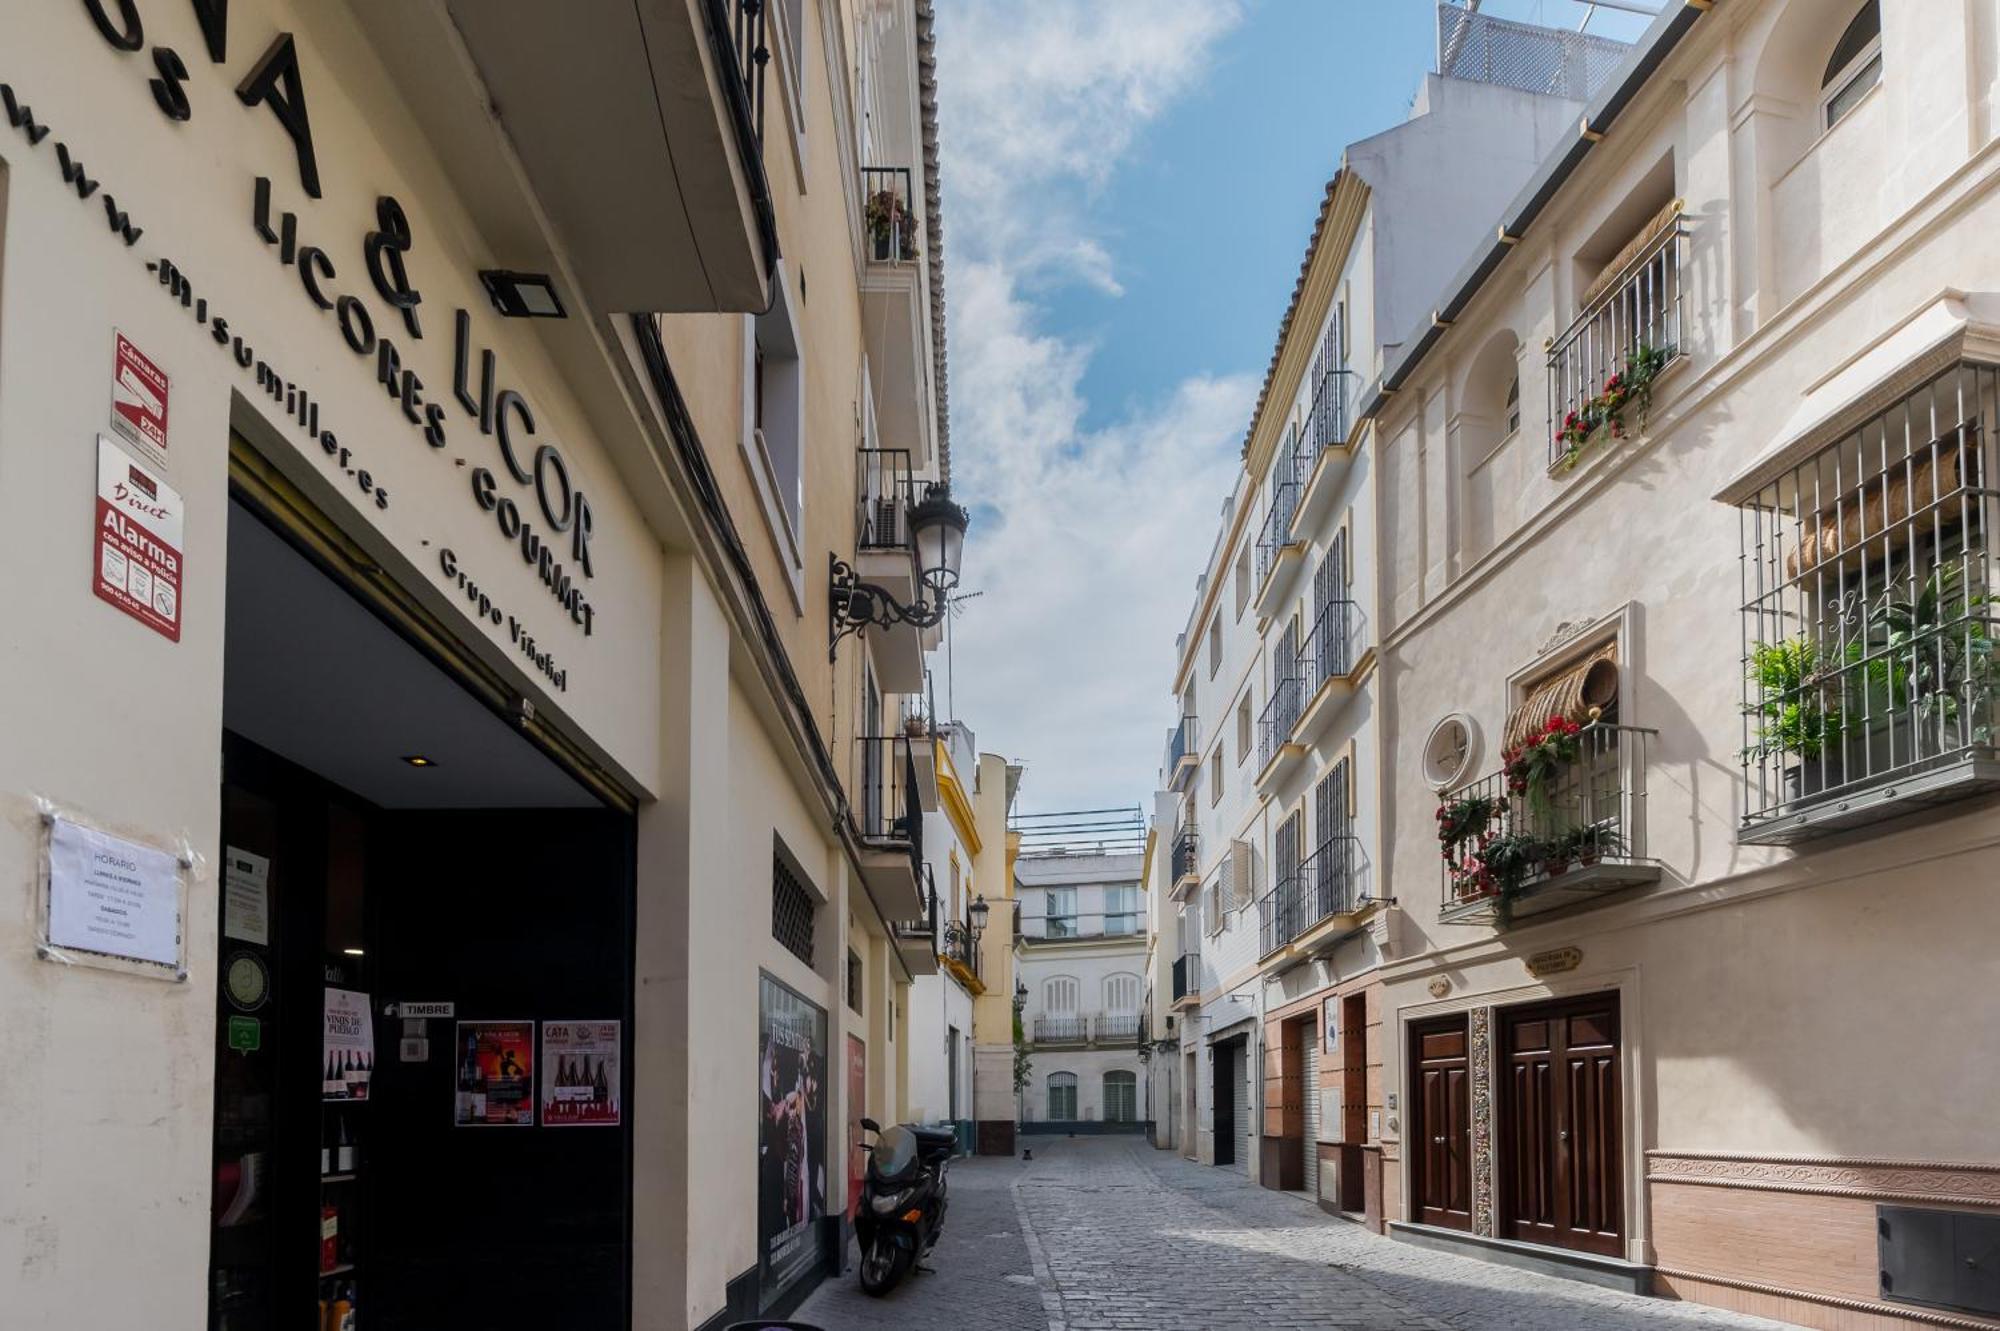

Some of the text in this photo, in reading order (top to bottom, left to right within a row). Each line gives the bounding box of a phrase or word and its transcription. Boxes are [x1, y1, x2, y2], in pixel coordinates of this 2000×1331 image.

[120, 340, 166, 389] Cámaras
[254, 177, 447, 448] LICORES
[471, 467, 595, 637] GOURMET
[364, 196, 423, 339] &
[454, 309, 594, 578] LICOR
[142, 416, 165, 444] 24H
[103, 509, 177, 574] Alarma
[103, 531, 119, 546] con
[120, 543, 143, 562] aviso
[440, 548, 502, 625] Grupo
[95, 855, 136, 871] HORARIO
[406, 1004, 450, 1015] TIMBRE
[545, 1025, 569, 1038] CATA
